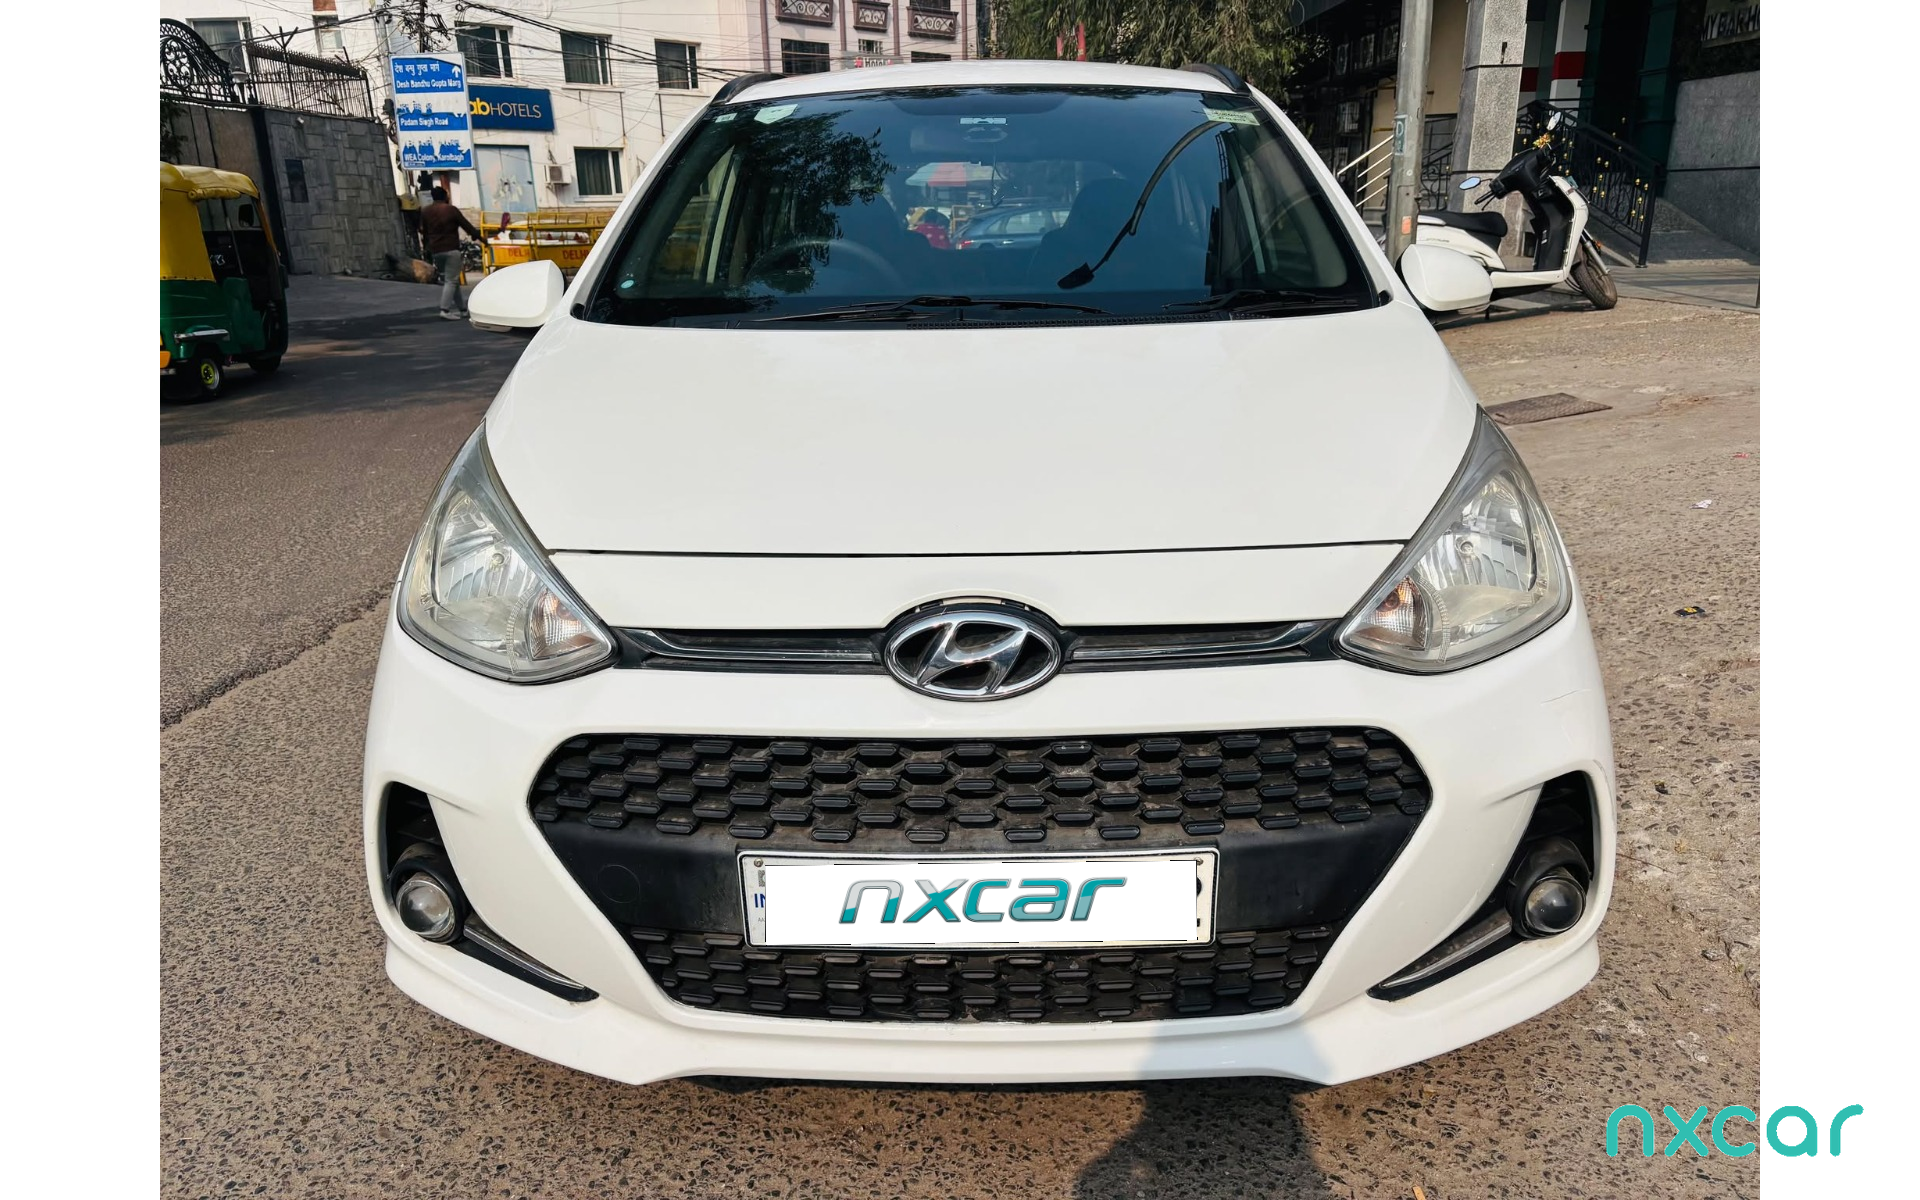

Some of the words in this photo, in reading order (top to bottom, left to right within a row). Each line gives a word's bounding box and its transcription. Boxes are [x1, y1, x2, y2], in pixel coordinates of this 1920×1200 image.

[396, 80, 410, 88] Desh
[410, 80, 430, 88] Bandhu
[431, 79, 447, 88] Gupta
[447, 79, 461, 88] Marg
[400, 118, 418, 126] Padam
[434, 118, 449, 126] Road
